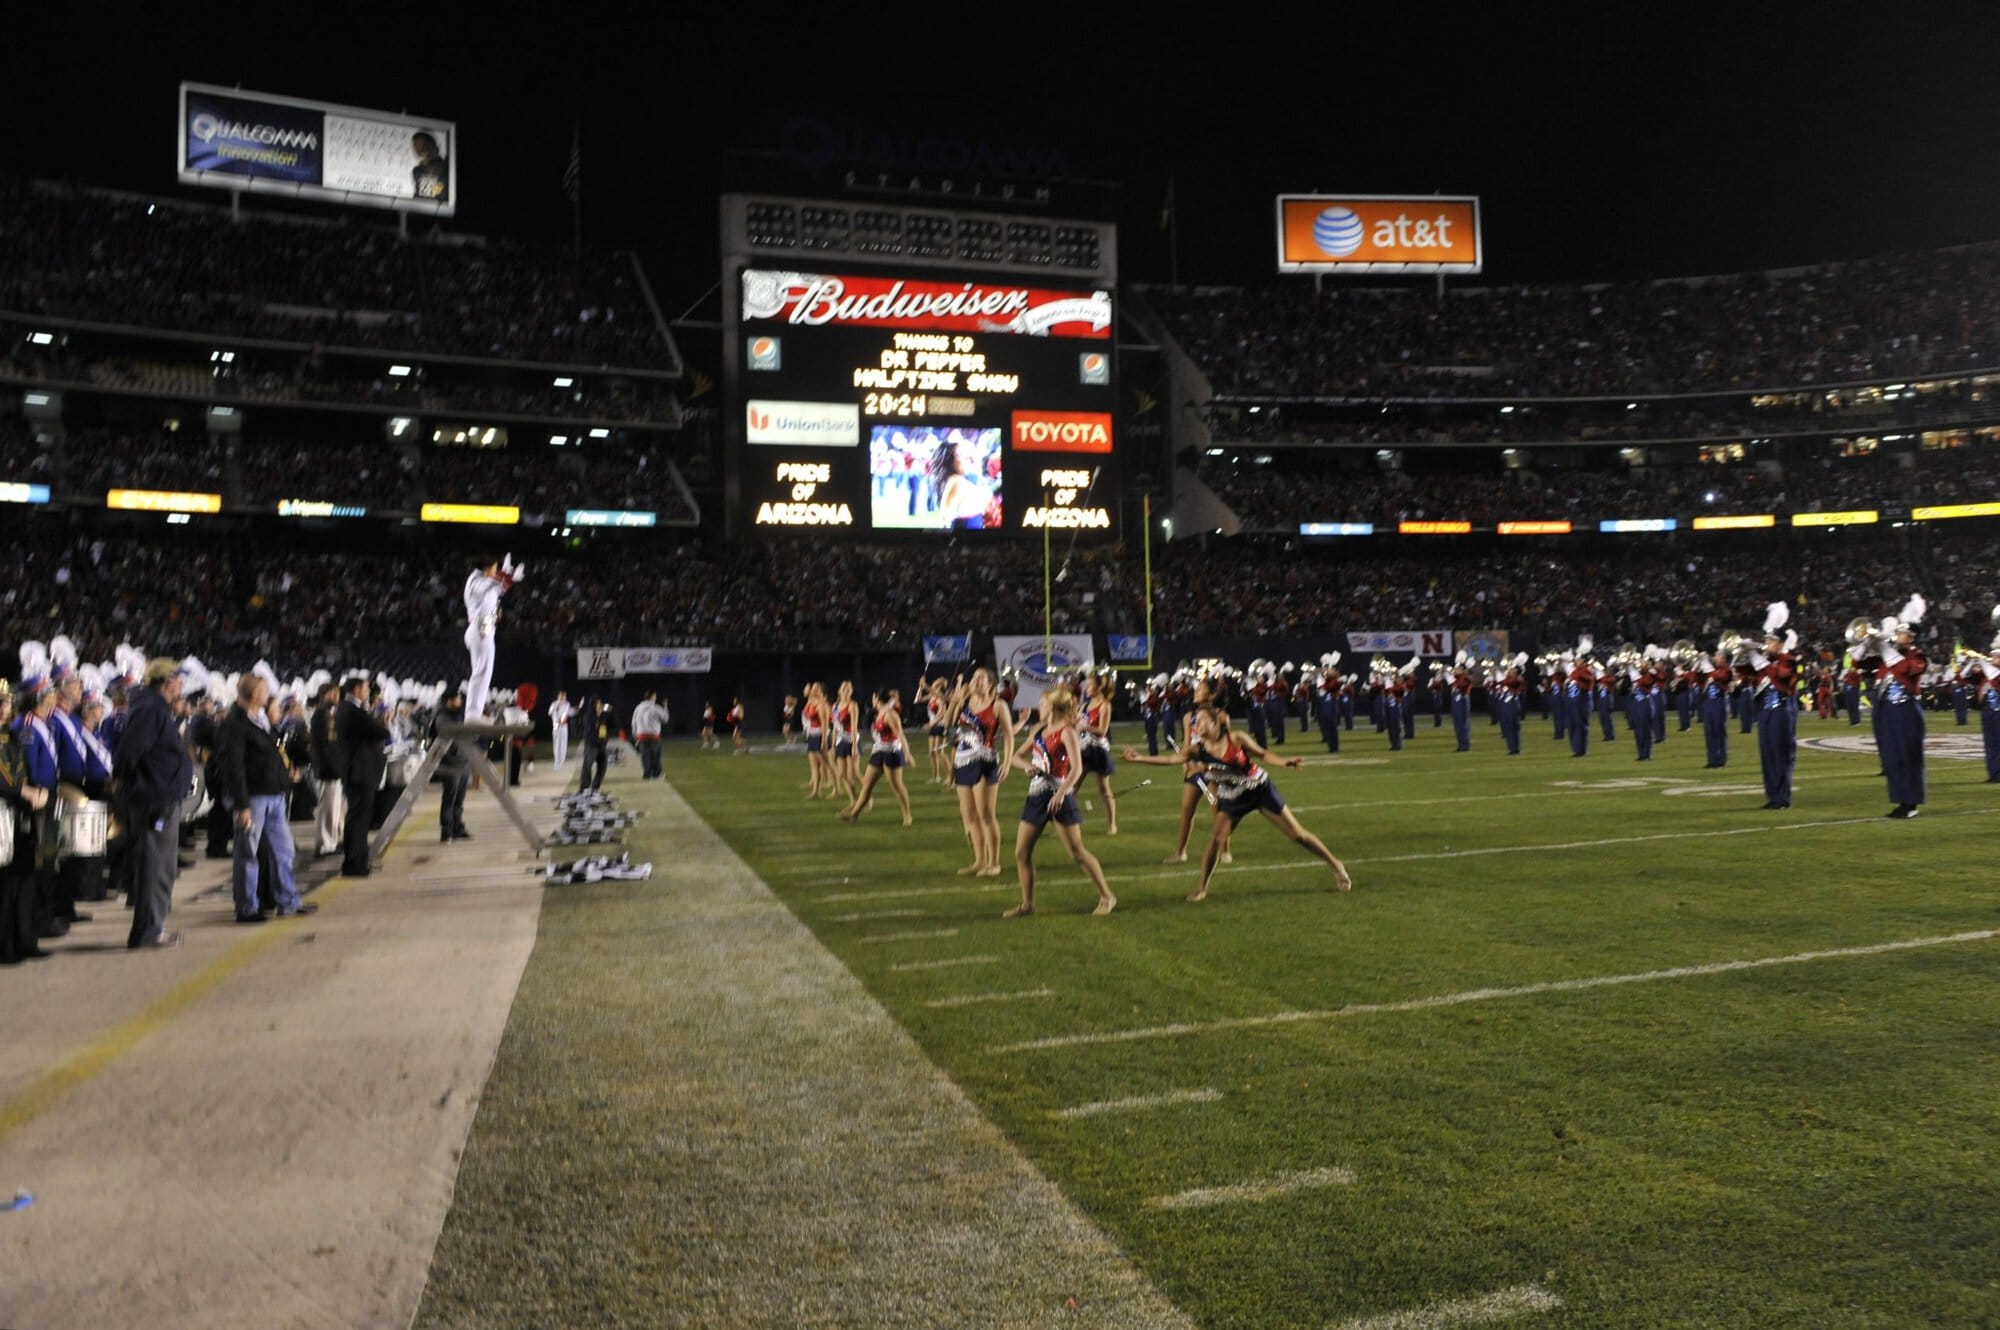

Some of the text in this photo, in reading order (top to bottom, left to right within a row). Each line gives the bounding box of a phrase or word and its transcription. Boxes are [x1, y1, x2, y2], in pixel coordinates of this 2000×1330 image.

[192, 113, 318, 151] QUALCOMM
[845, 169, 1050, 201] STADIUM
[1372, 213, 1454, 248] at&t
[780, 278, 1029, 326] Budweiser
[953, 336, 975, 353] TO
[881, 349, 987, 373] DR PEPPER
[853, 368, 1020, 393] HALFTIME SHOW
[1016, 421, 1109, 444] TOYOTA
[776, 463, 831, 483] PRIDE
[1041, 469, 1090, 488] PRIDE
[792, 482, 817, 501] OF
[1054, 488, 1077, 505] OF
[755, 502, 853, 525] ARIZONA
[1022, 507, 1110, 528] ARIZONA
[1422, 633, 1444, 654] N
